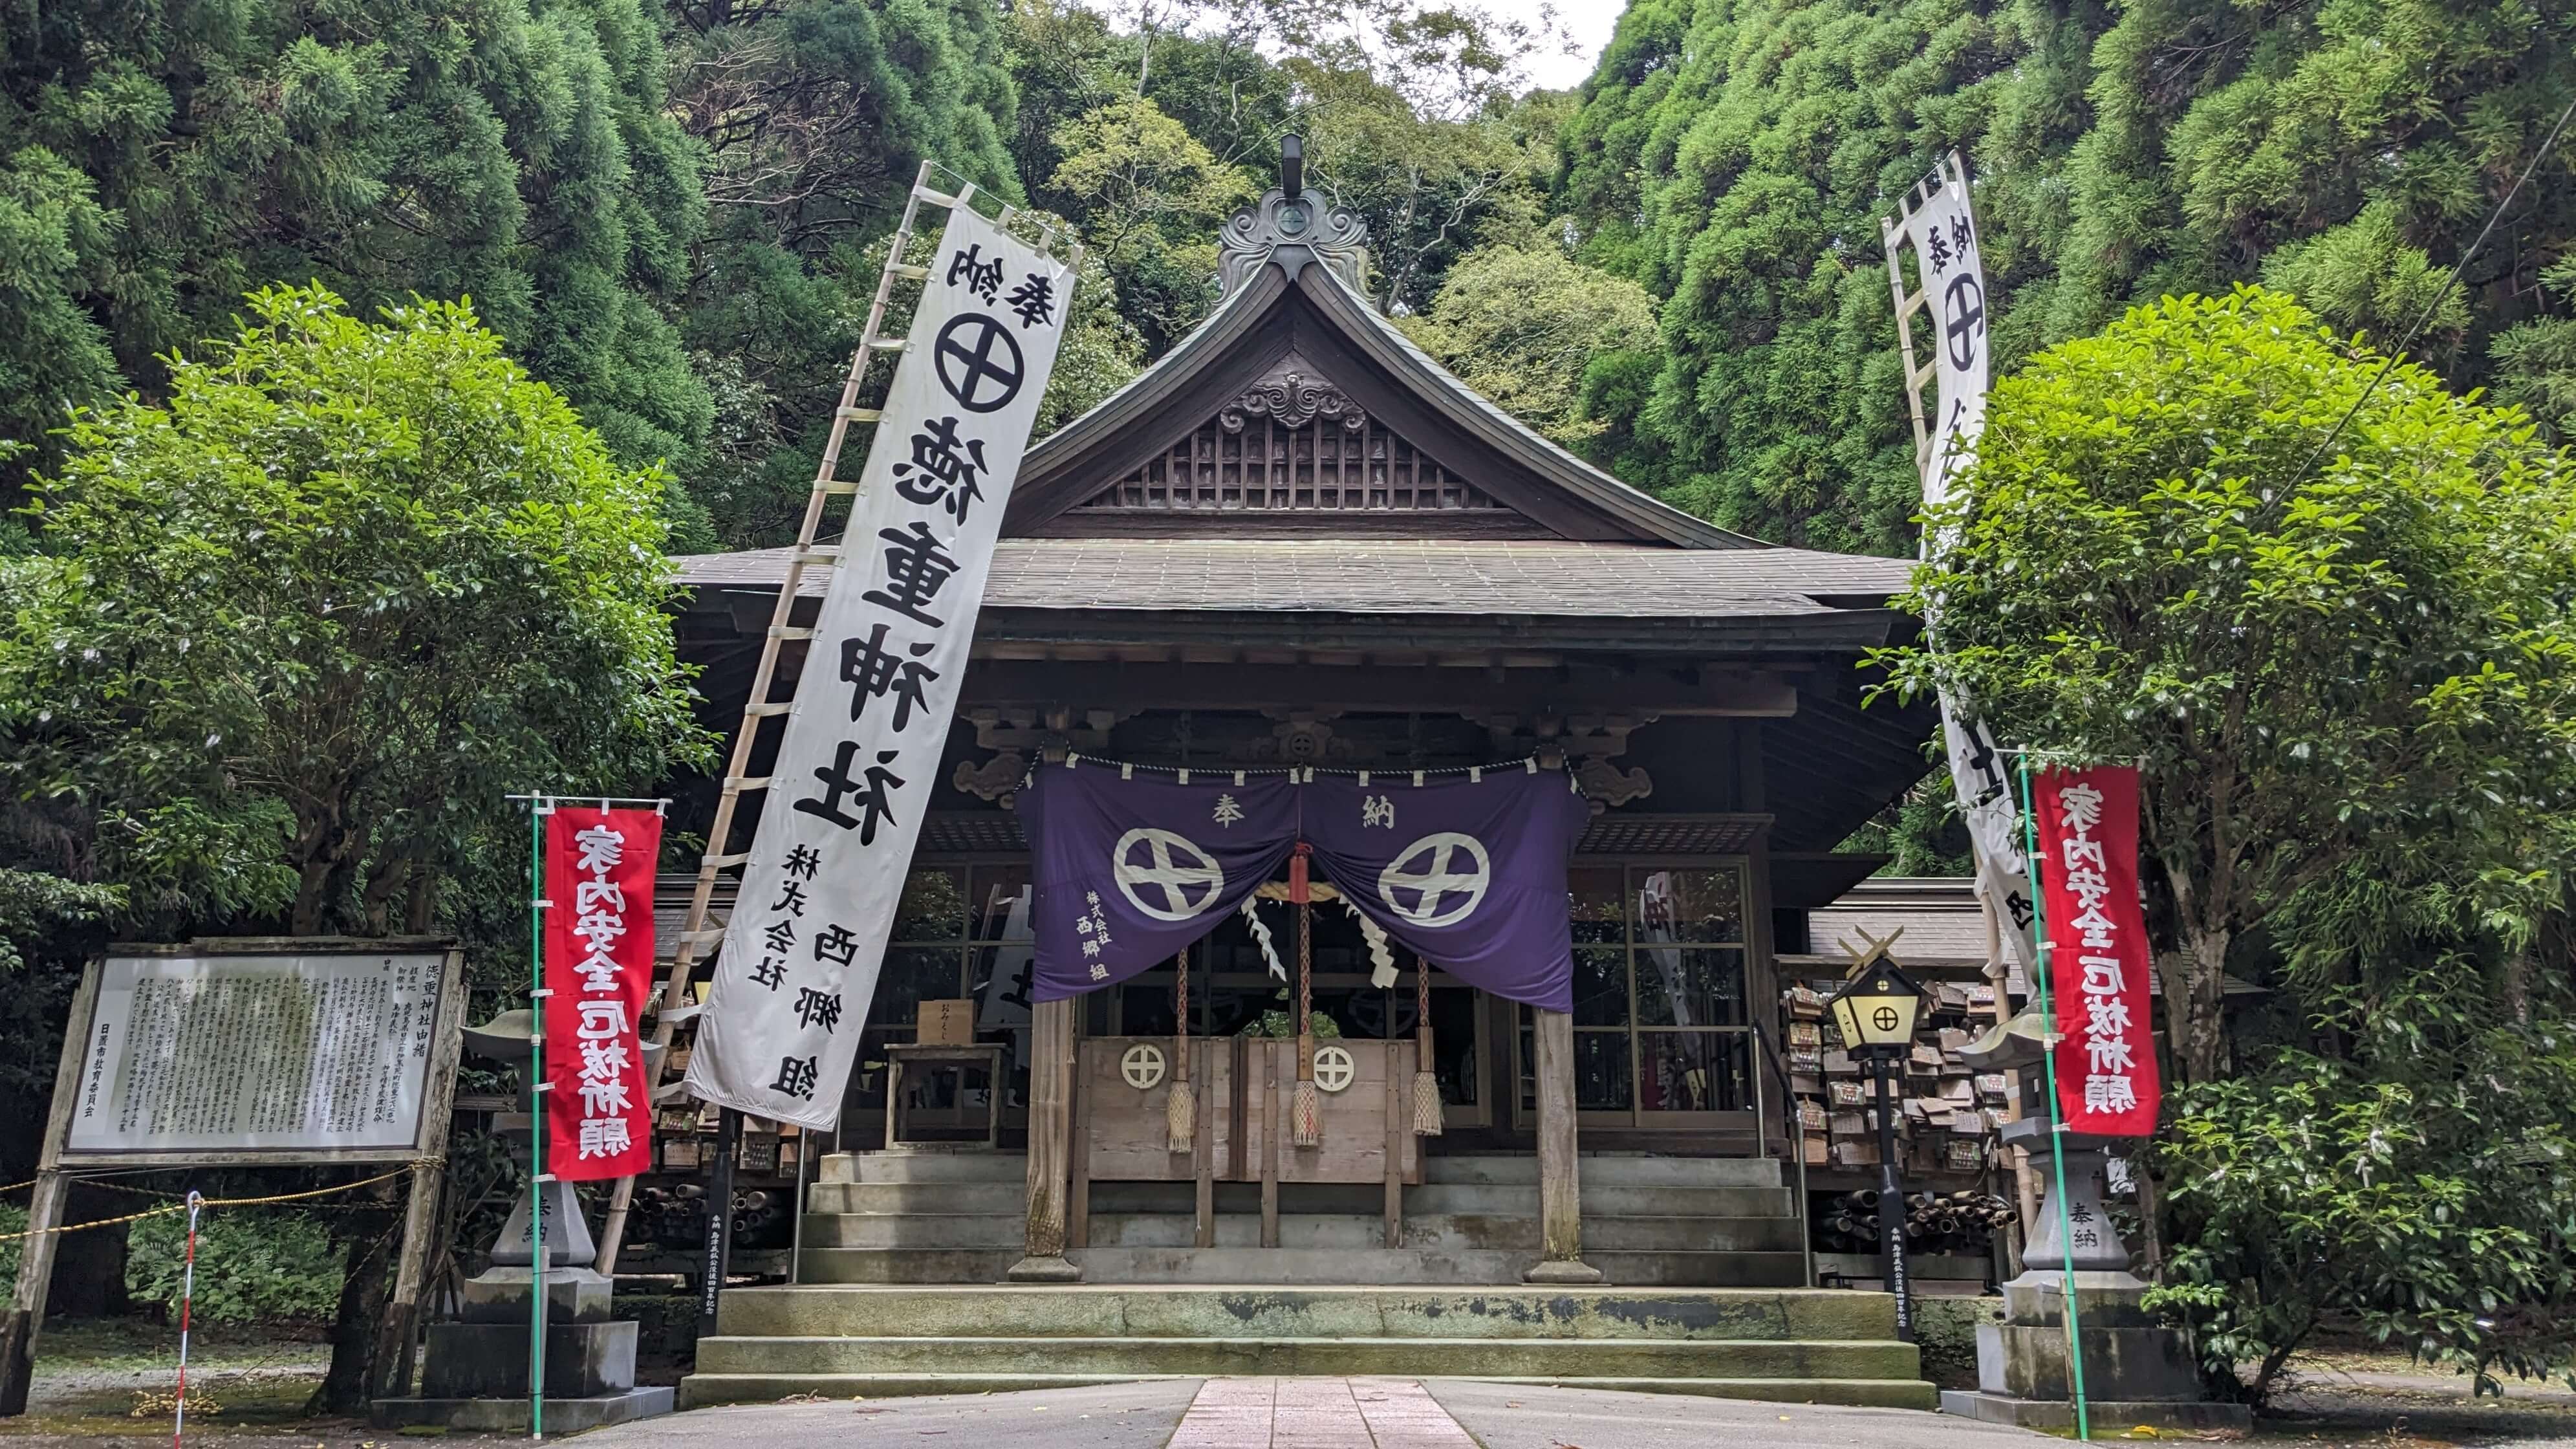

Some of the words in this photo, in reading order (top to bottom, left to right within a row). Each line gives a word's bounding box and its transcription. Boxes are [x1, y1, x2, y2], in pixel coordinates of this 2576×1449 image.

[1928, 210, 1975, 279] 奉納
[1076, 916, 1110, 981] 西郷組
[1086, 890, 1113, 945] 株式会社
[413, 964, 440, 1057] 徳重神社由緒
[84, 1023, 110, 1118] 日置市教育委員会
[2070, 1203, 2099, 1248] 奉納
